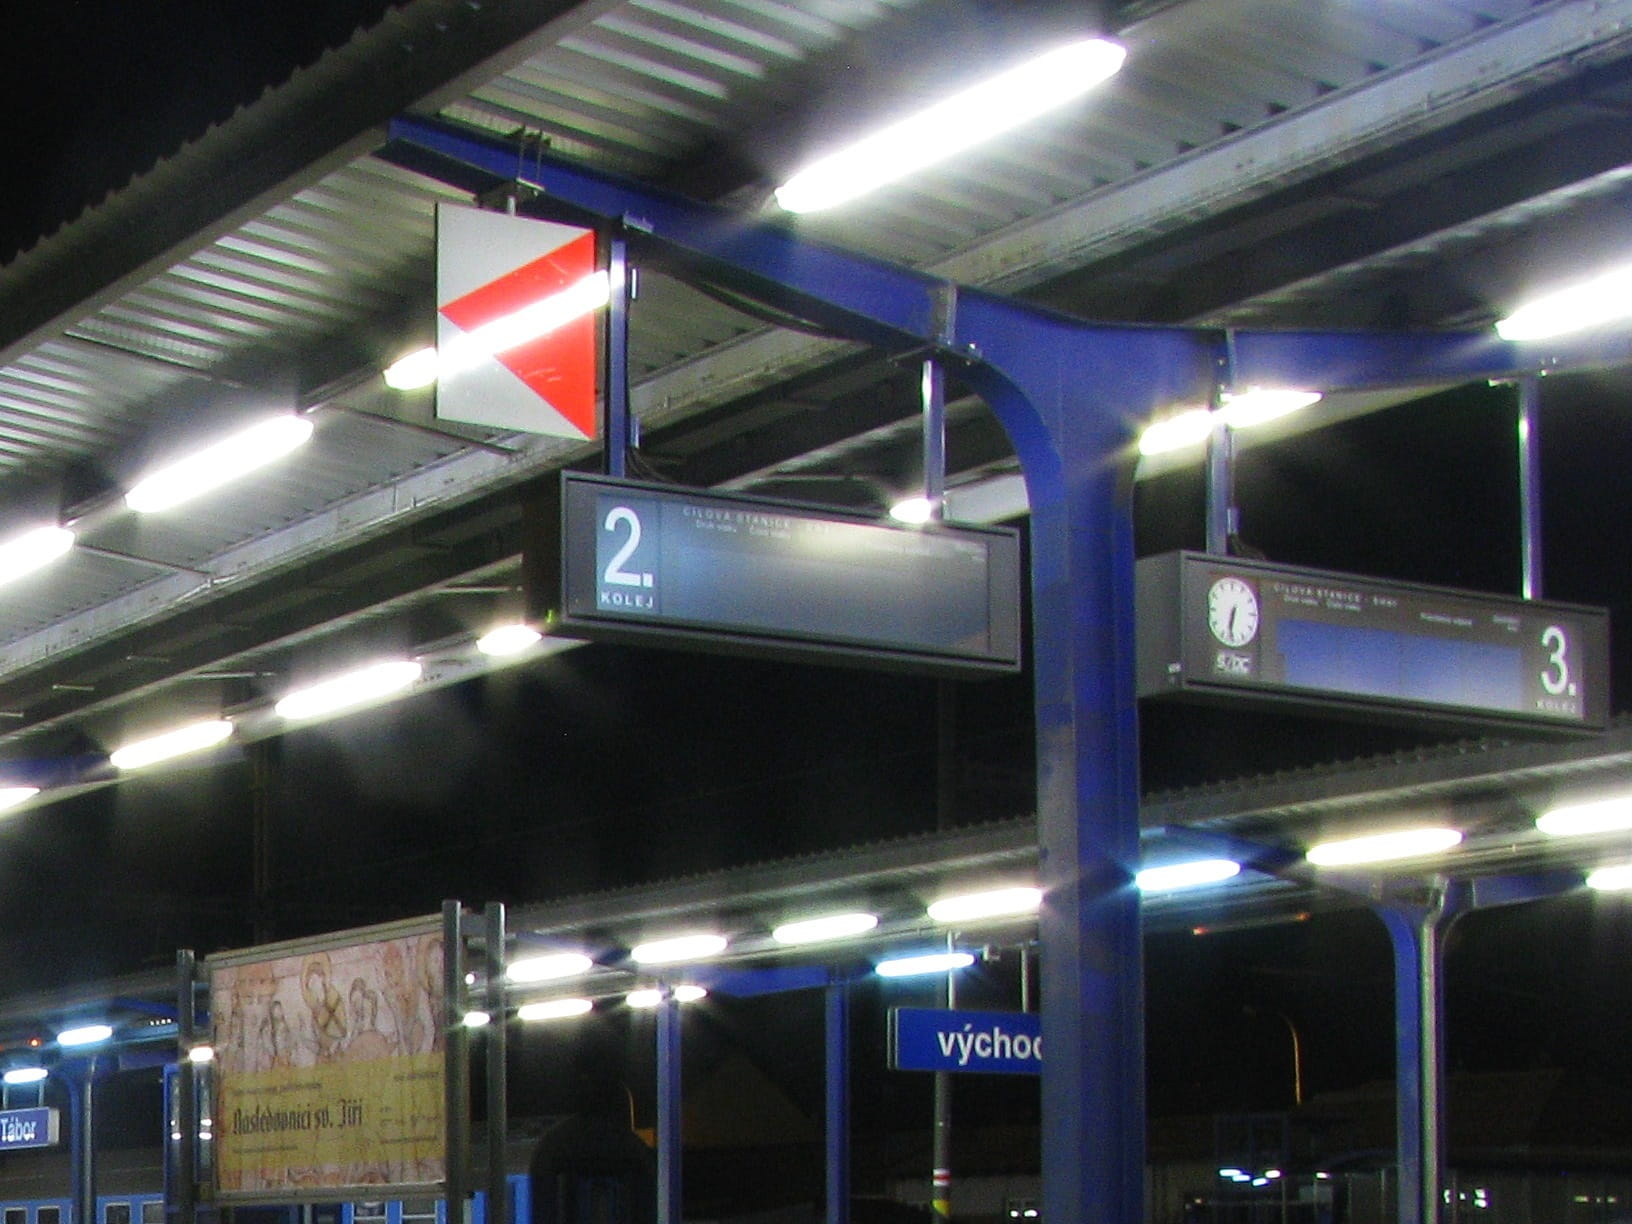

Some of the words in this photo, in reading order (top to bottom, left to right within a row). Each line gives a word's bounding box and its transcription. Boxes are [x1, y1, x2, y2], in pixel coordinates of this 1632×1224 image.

[604, 506, 653, 587] 2.
[601, 590, 654, 609] KOLEJ
[1540, 626, 1577, 696] 3.
[0, 1116, 37, 1142] Tábor
